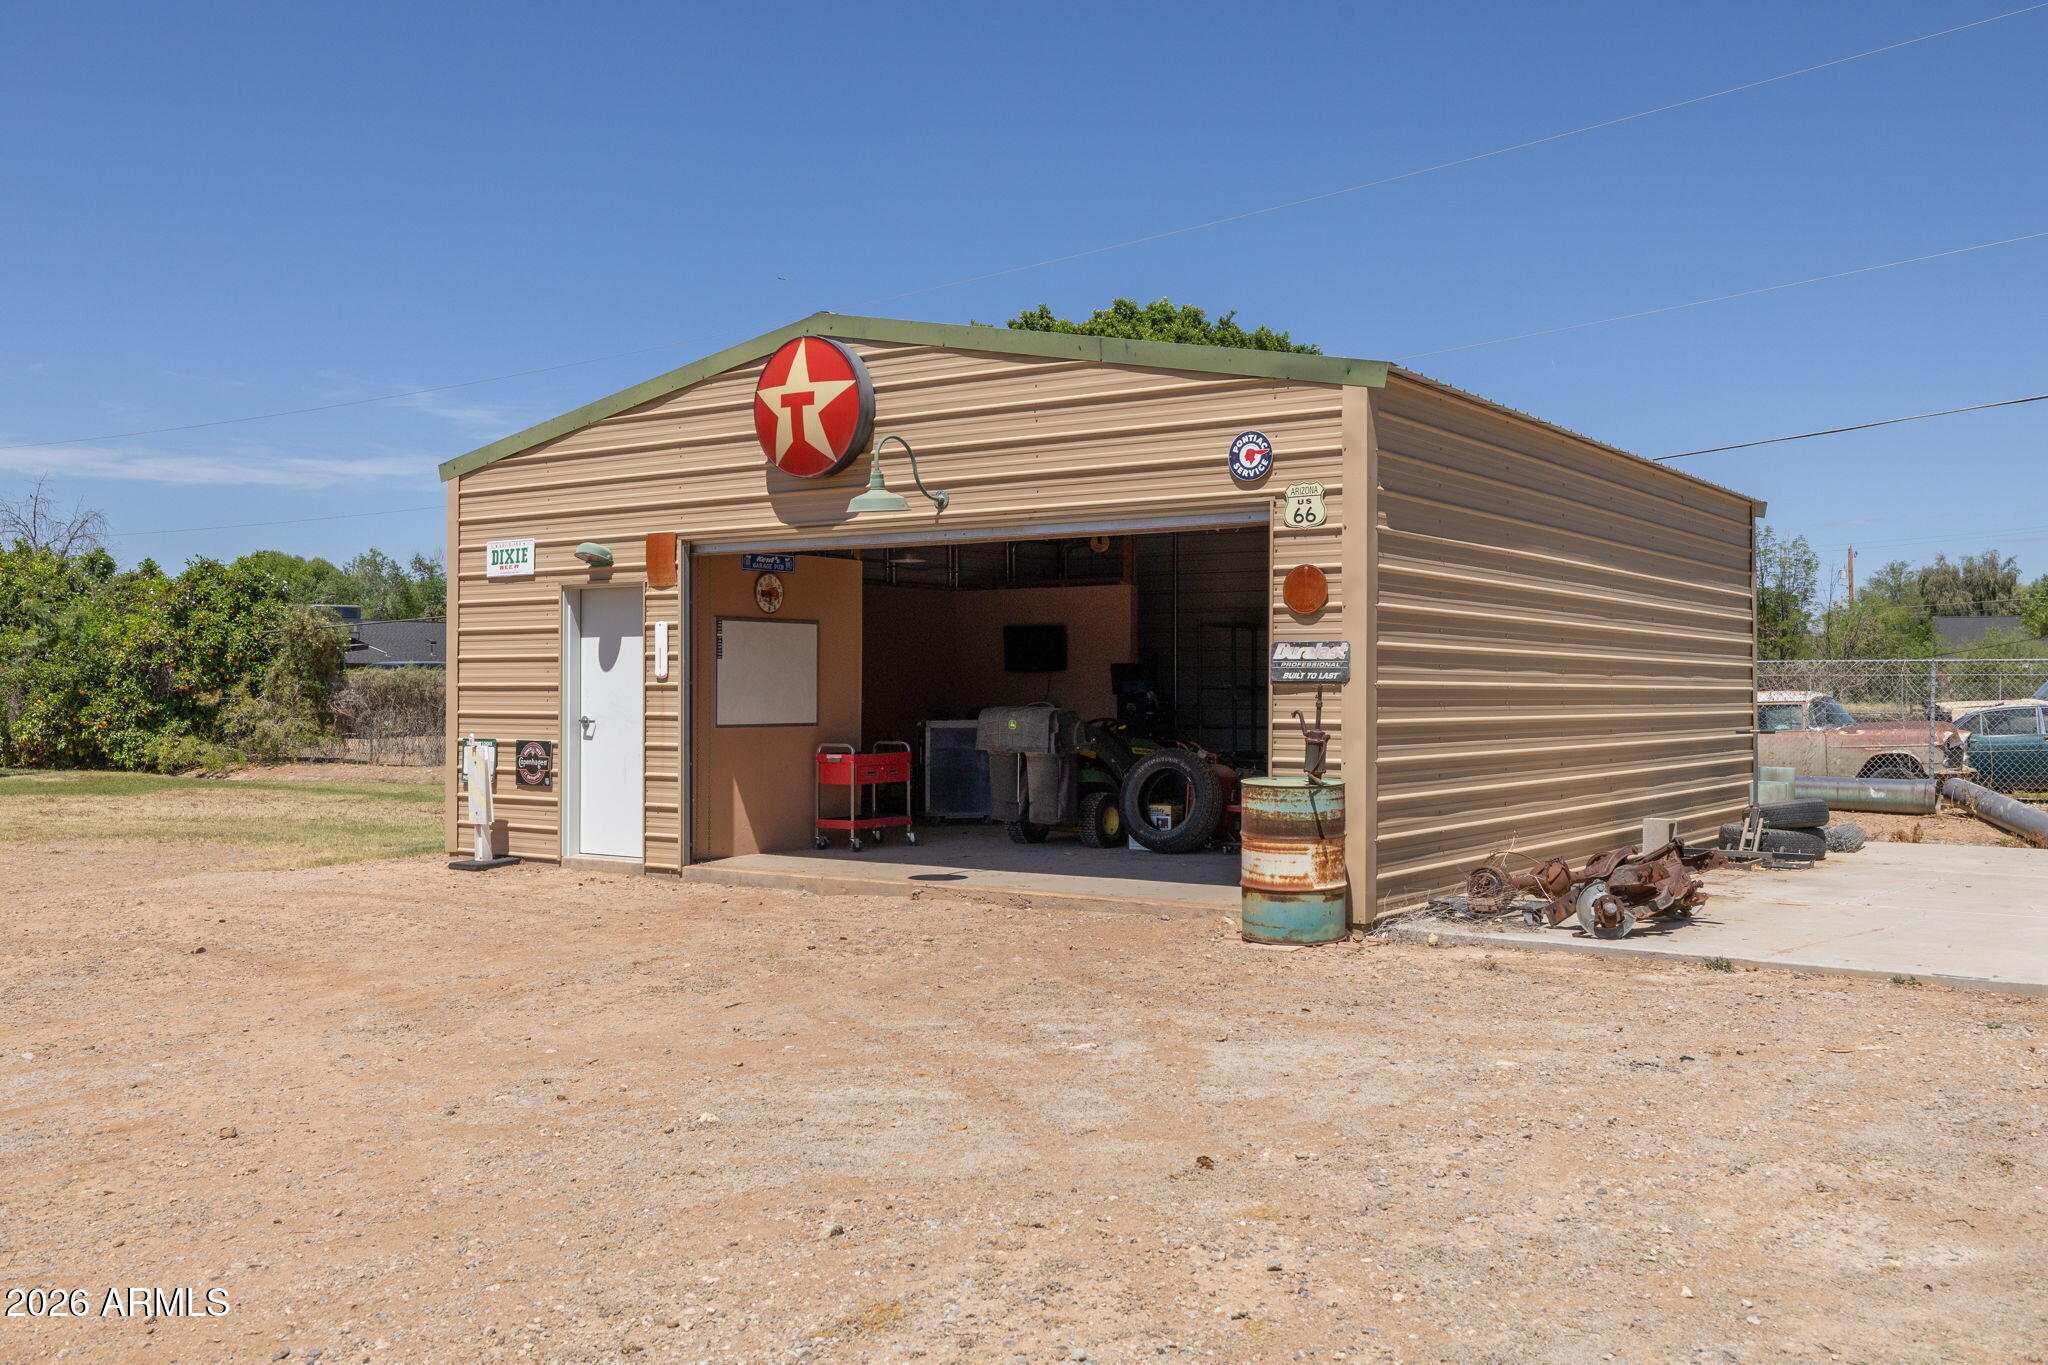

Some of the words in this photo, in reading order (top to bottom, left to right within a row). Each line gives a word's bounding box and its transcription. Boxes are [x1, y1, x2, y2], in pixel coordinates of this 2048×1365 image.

[781, 391, 815, 443] T
[1233, 434, 1269, 454] PONTIAC
[1233, 459, 1269, 477] SERVICE
[1290, 486, 1319, 496] ARIZONA
[1293, 507, 1316, 524] 66
[491, 547, 528, 566] DIXIE
[1272, 642, 1349, 660] Duralast
[1282, 672, 1306, 680] BUILT
[1306, 672, 1318, 680] TO
[1318, 672, 1340, 680] LAST
[518, 756, 548, 770] Copenhagen
